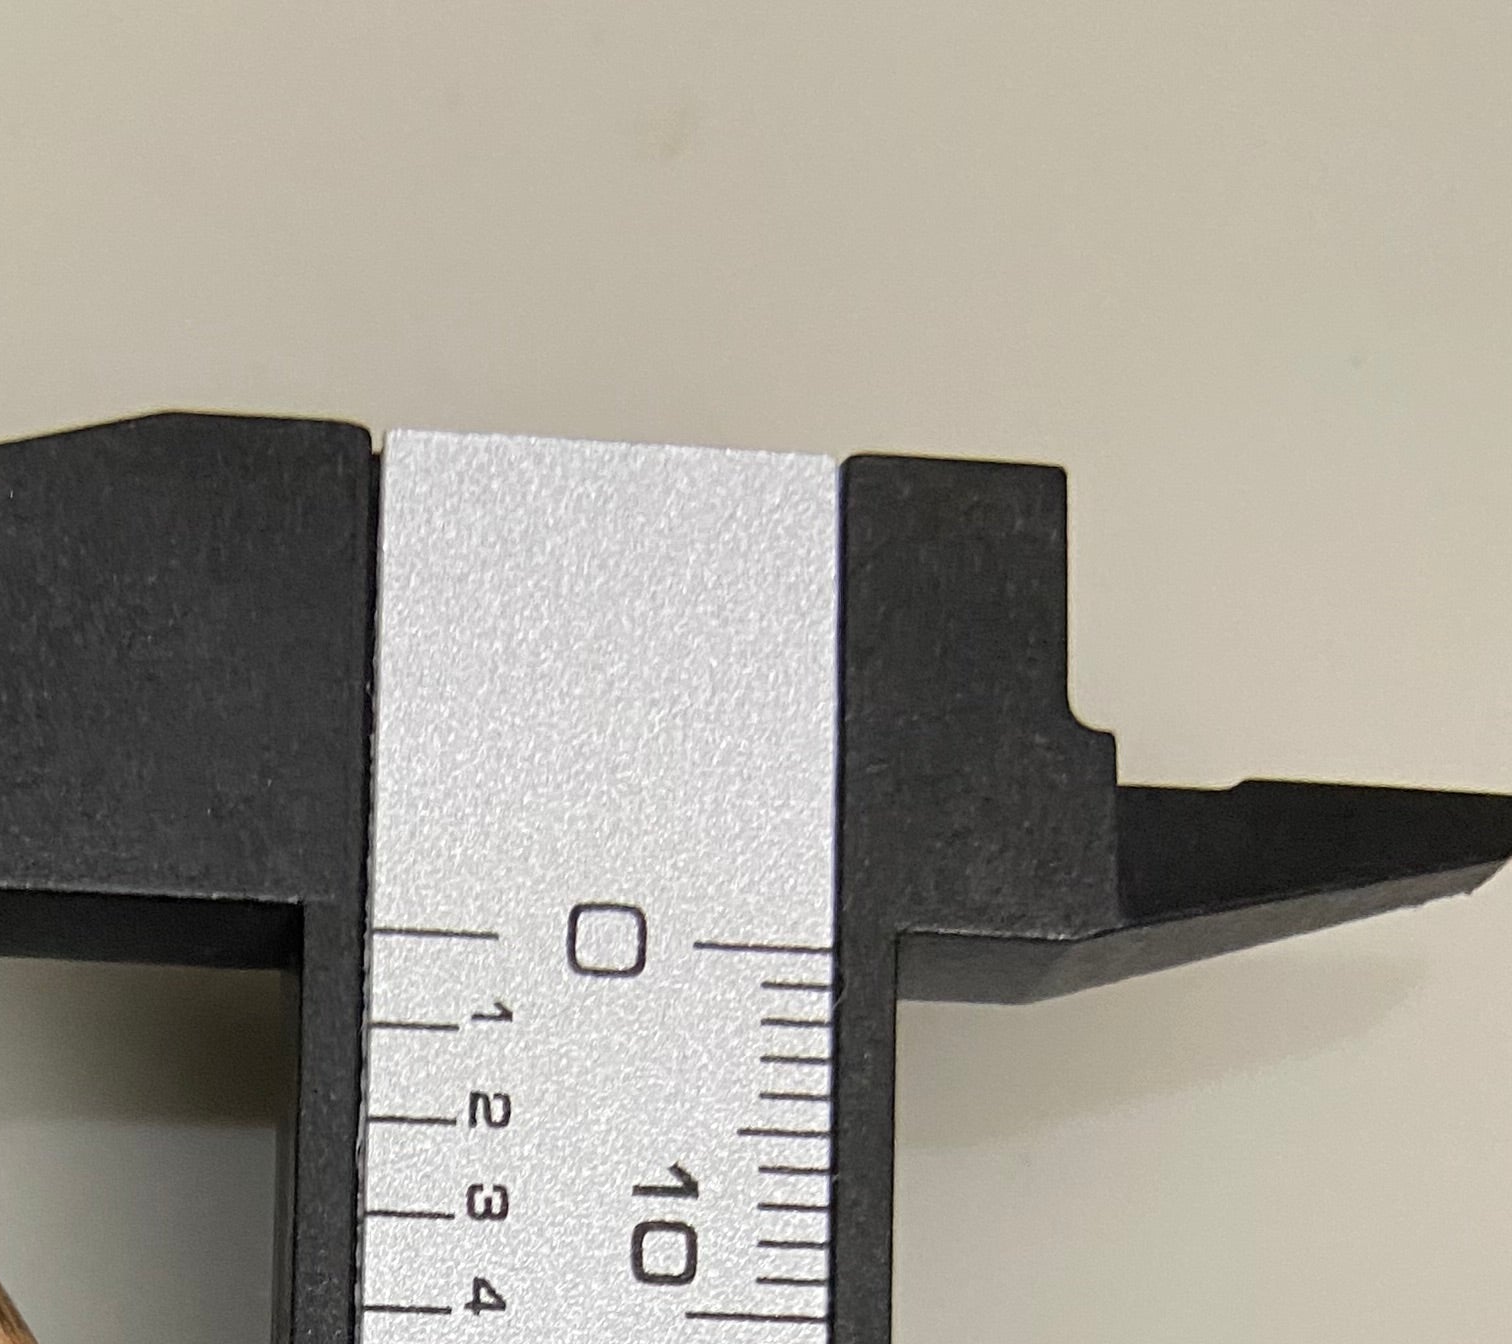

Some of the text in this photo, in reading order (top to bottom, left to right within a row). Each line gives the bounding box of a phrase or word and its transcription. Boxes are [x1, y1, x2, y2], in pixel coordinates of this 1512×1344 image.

[564, 899, 650, 981] 0
[469, 998, 515, 1024] 1
[466, 1089, 514, 1131] 2
[464, 1181, 512, 1224] 3
[628, 1160, 701, 1288] 10
[462, 1274, 509, 1318] 4
